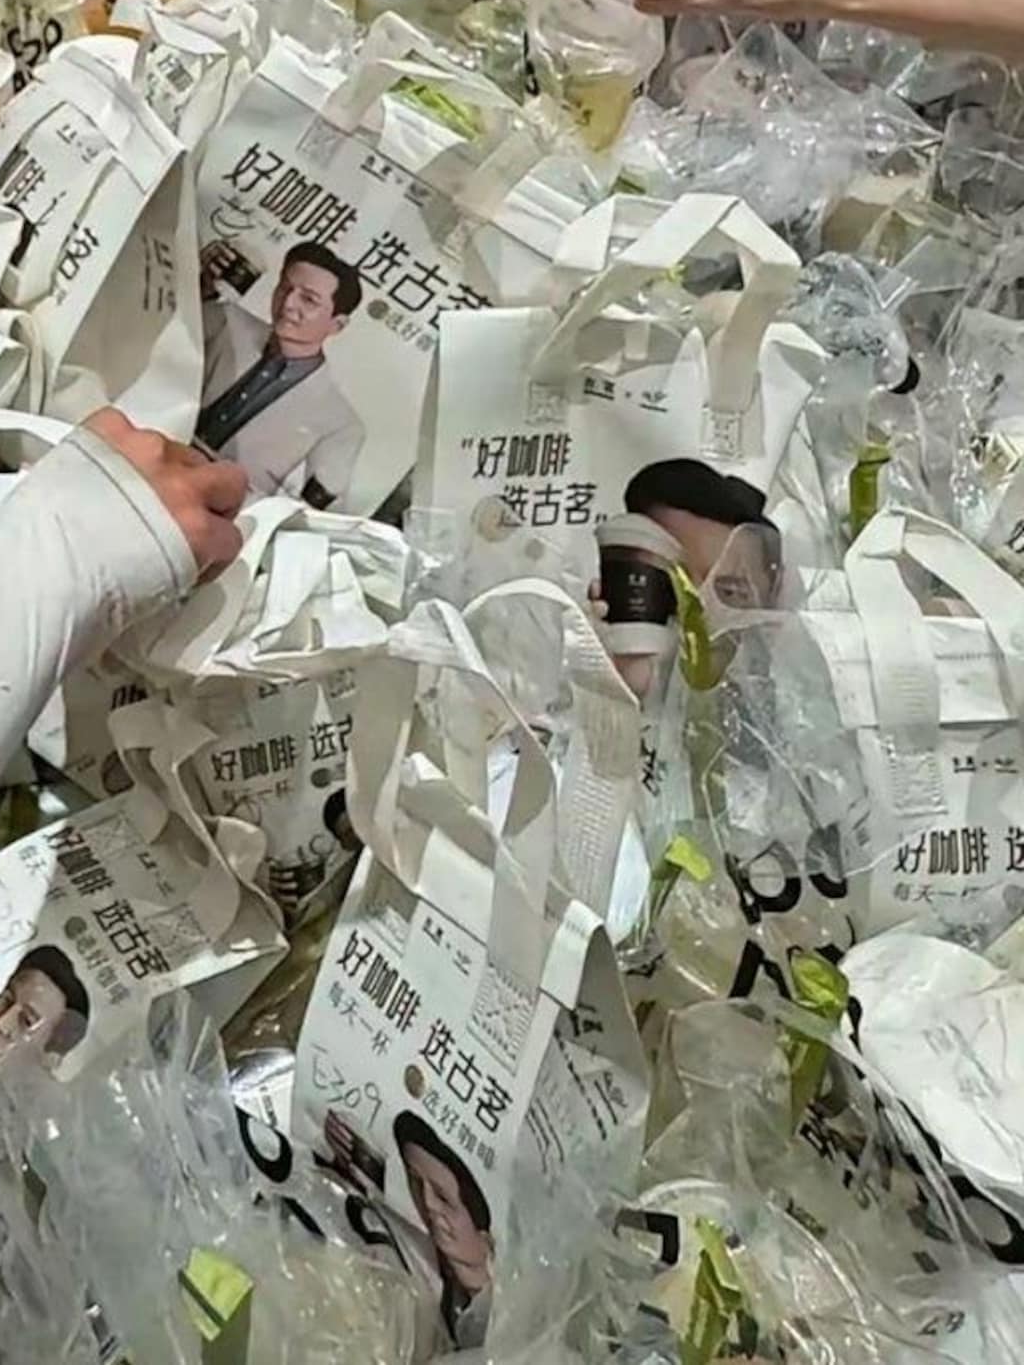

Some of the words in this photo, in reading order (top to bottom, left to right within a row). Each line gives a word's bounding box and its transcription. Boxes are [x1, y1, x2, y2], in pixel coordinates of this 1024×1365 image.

[223, 141, 358, 246] 好咖啡
[211, 735, 296, 781] 好咖啡
[893, 827, 990, 874] 好咖啡
[336, 929, 423, 1033] 好咖啡
[419, 1018, 514, 1133] 选古茗
